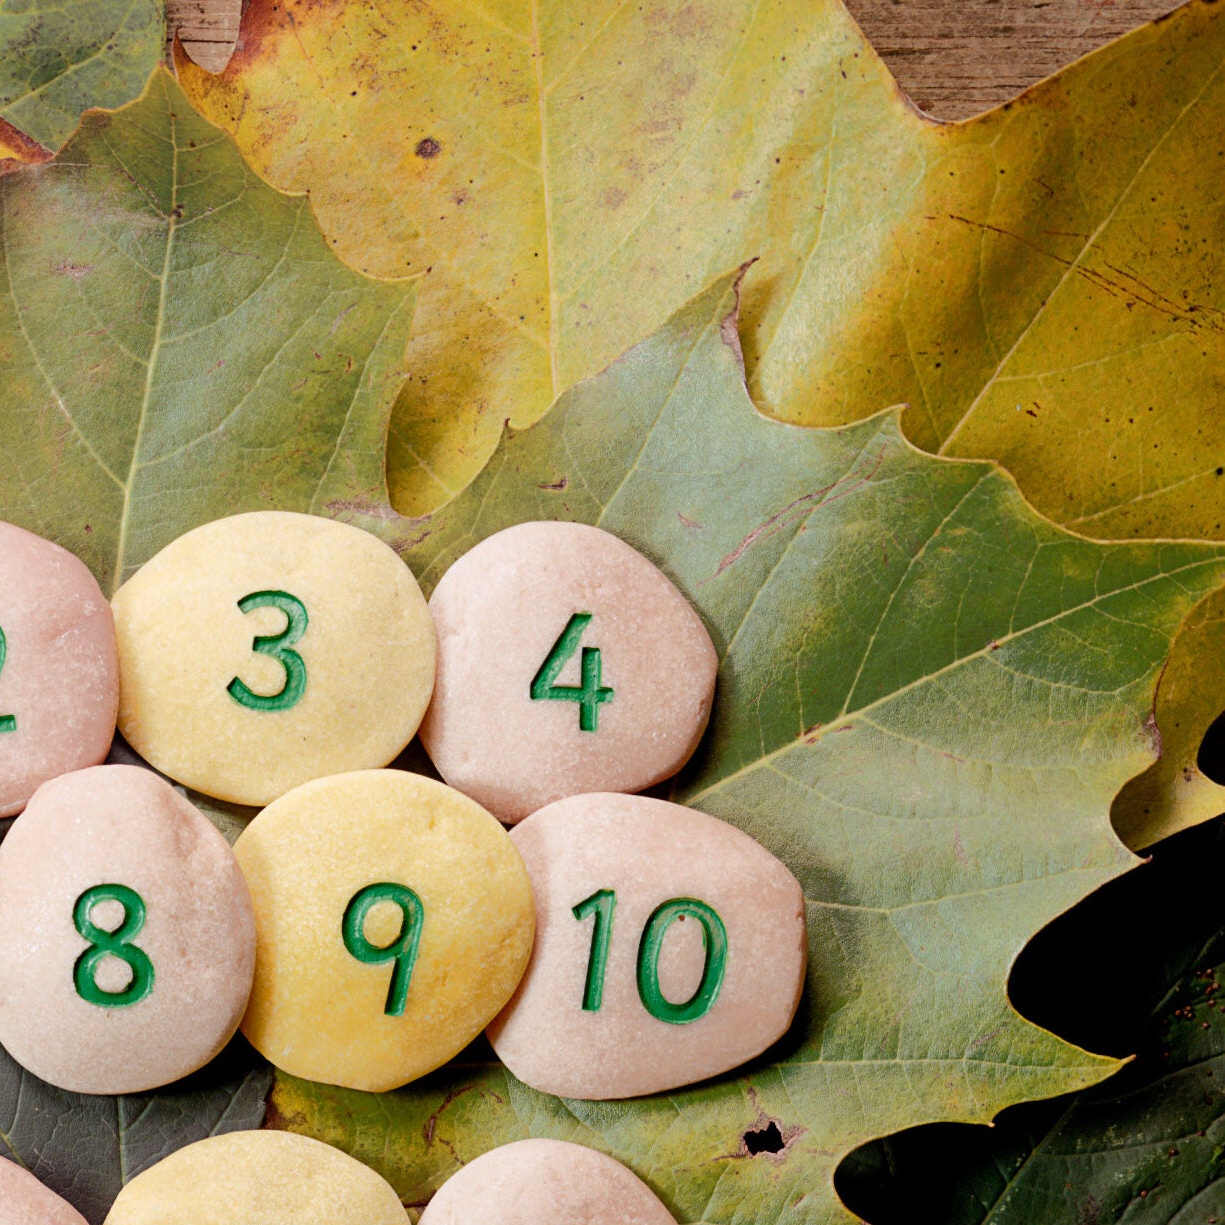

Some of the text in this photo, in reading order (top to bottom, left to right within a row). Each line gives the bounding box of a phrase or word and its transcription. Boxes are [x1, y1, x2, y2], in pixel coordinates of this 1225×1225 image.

[229, 591, 309, 712] 3
[531, 612, 614, 733] 4
[74, 885, 156, 1008] 8
[343, 883, 424, 1016] 9
[572, 891, 728, 1025] 10
